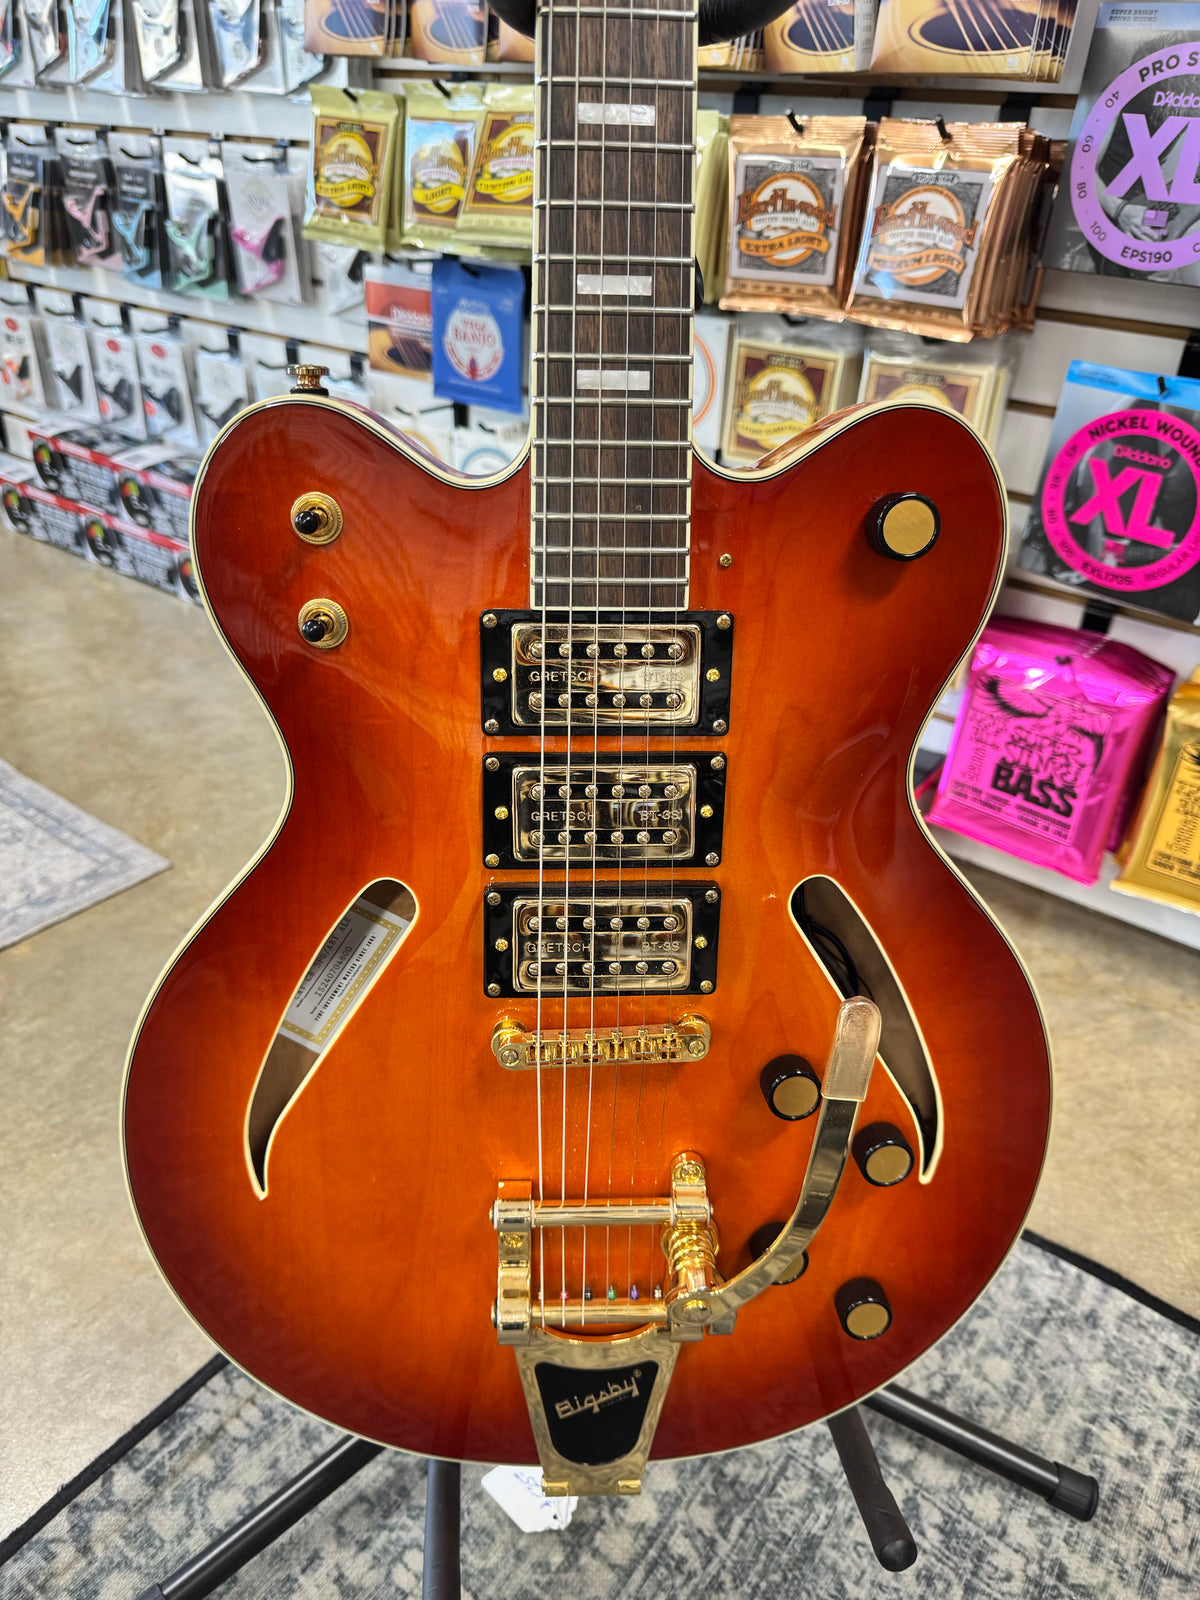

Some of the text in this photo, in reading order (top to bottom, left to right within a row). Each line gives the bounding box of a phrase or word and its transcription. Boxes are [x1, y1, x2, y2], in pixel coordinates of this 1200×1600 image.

[1139, 54, 1180, 83] PRO
[1105, 91, 1120, 108] 40
[1082, 135, 1094, 153] 60
[1077, 182, 1087, 199] 80
[736, 187, 838, 231] Earthwood
[871, 201, 979, 250] Earthwood
[1090, 221, 1107, 242] 100
[745, 234, 823, 253] EXTRA LIGHT
[924, 254, 961, 269] LIGHT
[1120, 246, 1172, 263] EPS190
[1089, 417, 1149, 441] NICKEL
[1068, 457, 1176, 549] XL
[530, 671, 597, 682] GRETSCH
[1009, 725, 1082, 758] SUPER
[991, 763, 1078, 818] BASS
[530, 811, 596, 821] GRETSCH
[526, 941, 592, 953] GRETSCH
[555, 1376, 640, 1419] Bigsby
